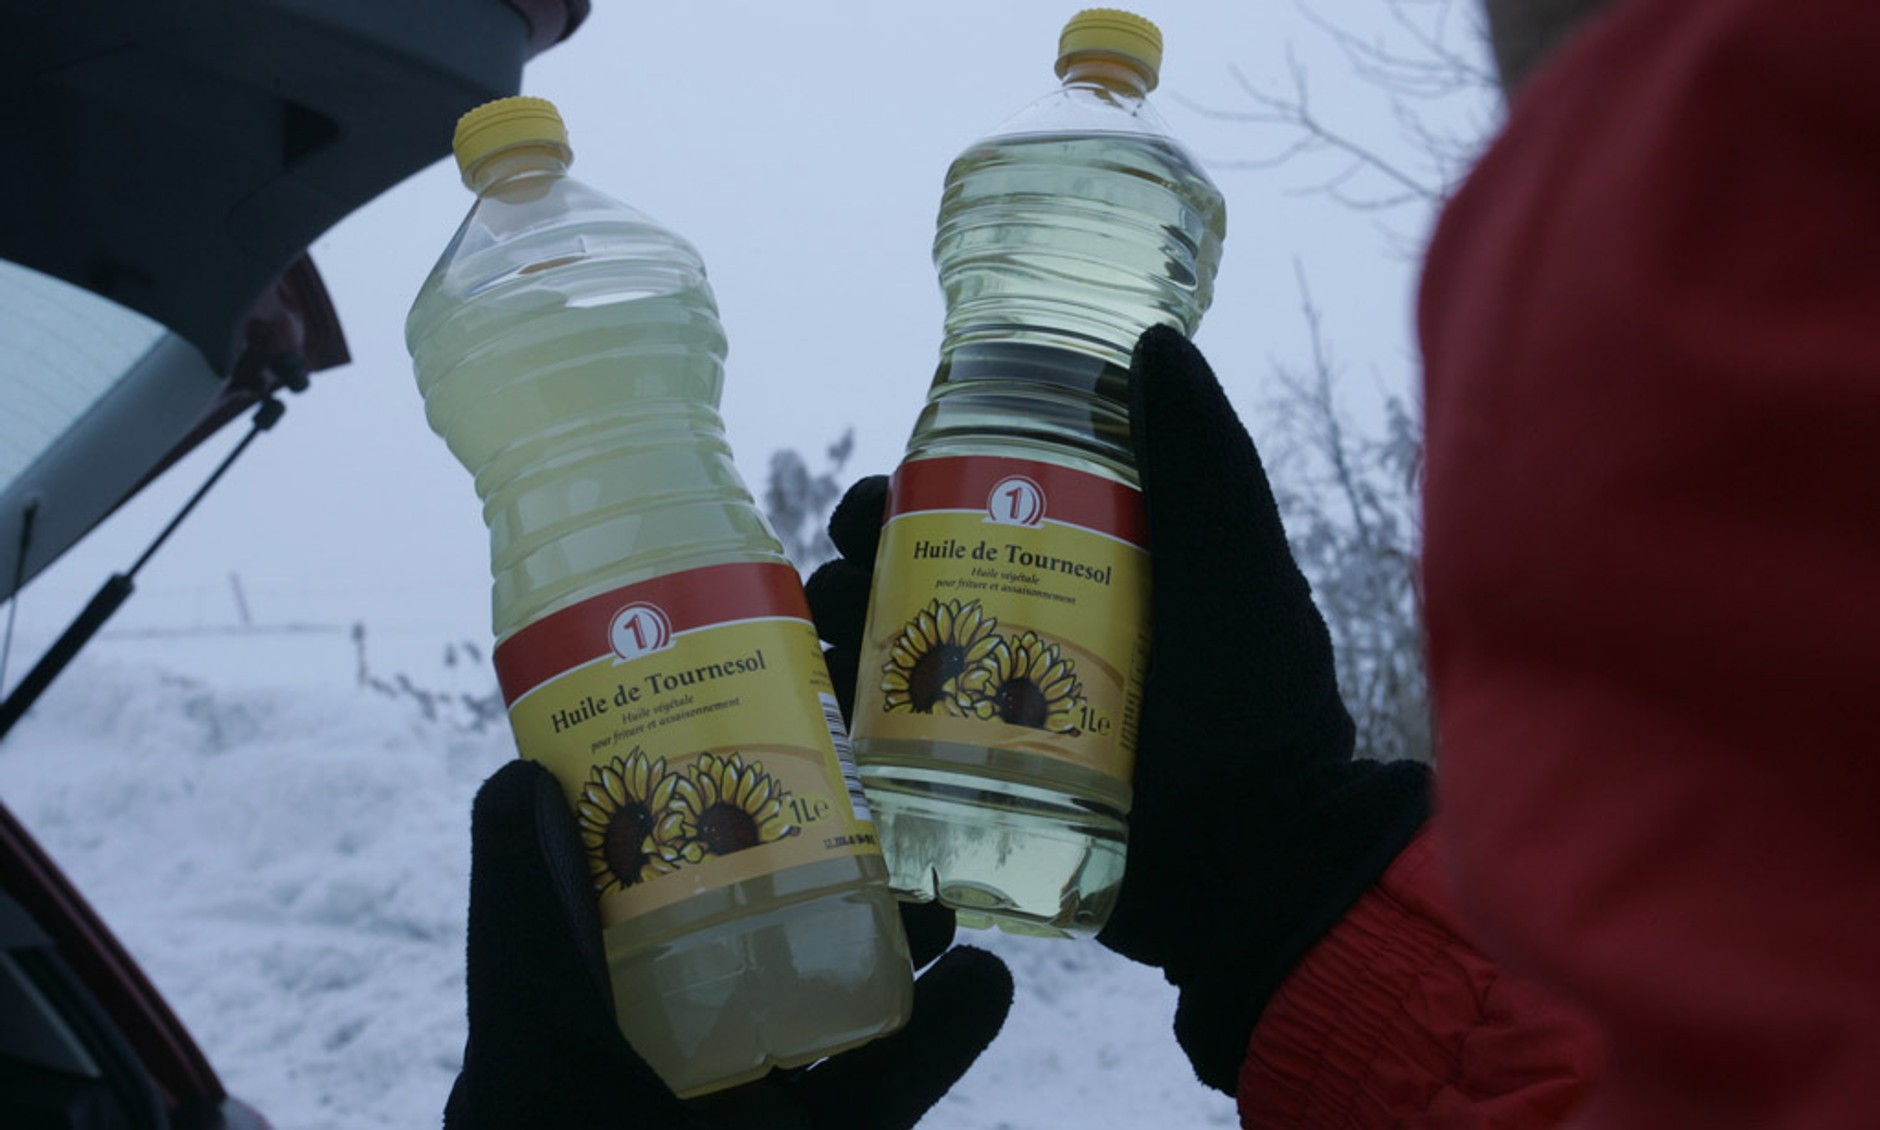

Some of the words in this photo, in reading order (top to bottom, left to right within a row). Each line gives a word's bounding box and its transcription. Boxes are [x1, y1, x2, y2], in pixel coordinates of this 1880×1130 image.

[1004, 486, 1024, 519] 1
[913, 538, 966, 560] Huile
[971, 540, 999, 562] de
[1004, 544, 1113, 586] Tournesol
[970, 566, 999, 579] Huile
[1000, 570, 1041, 586] végétale
[934, 578, 957, 590] pour
[956, 577, 988, 591] friture
[989, 582, 999, 592] et
[1000, 584, 1077, 605] assaisonnement
[623, 613, 649, 651] 1
[551, 696, 609, 734] Huile
[613, 684, 642, 708] de
[644, 649, 767, 695] Tournesol
[590, 736, 612, 755] pour
[612, 724, 645, 747] friture
[646, 718, 658, 730] et
[658, 696, 742, 727] assaisonnement
[621, 708, 651, 726] Huile
[652, 694, 696, 718] végétale
